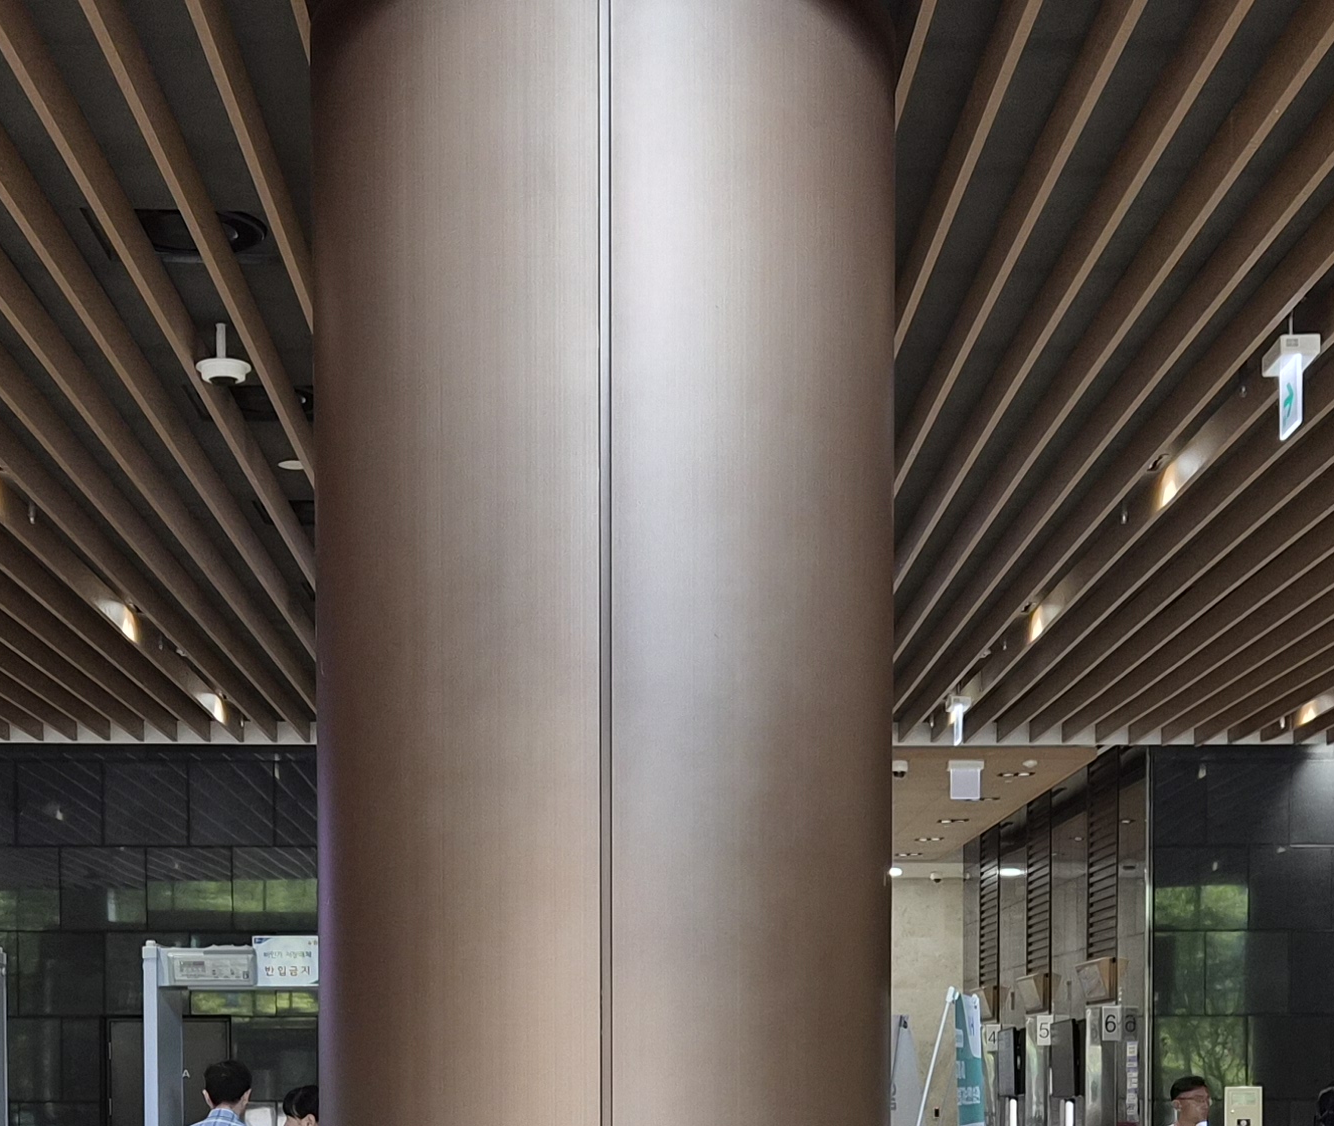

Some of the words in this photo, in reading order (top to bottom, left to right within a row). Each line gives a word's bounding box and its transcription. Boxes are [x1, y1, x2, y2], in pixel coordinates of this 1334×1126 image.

[1038, 1022, 1051, 1039] 5
[1104, 1014, 1118, 1033] 6
[987, 1031, 997, 1044] 4
